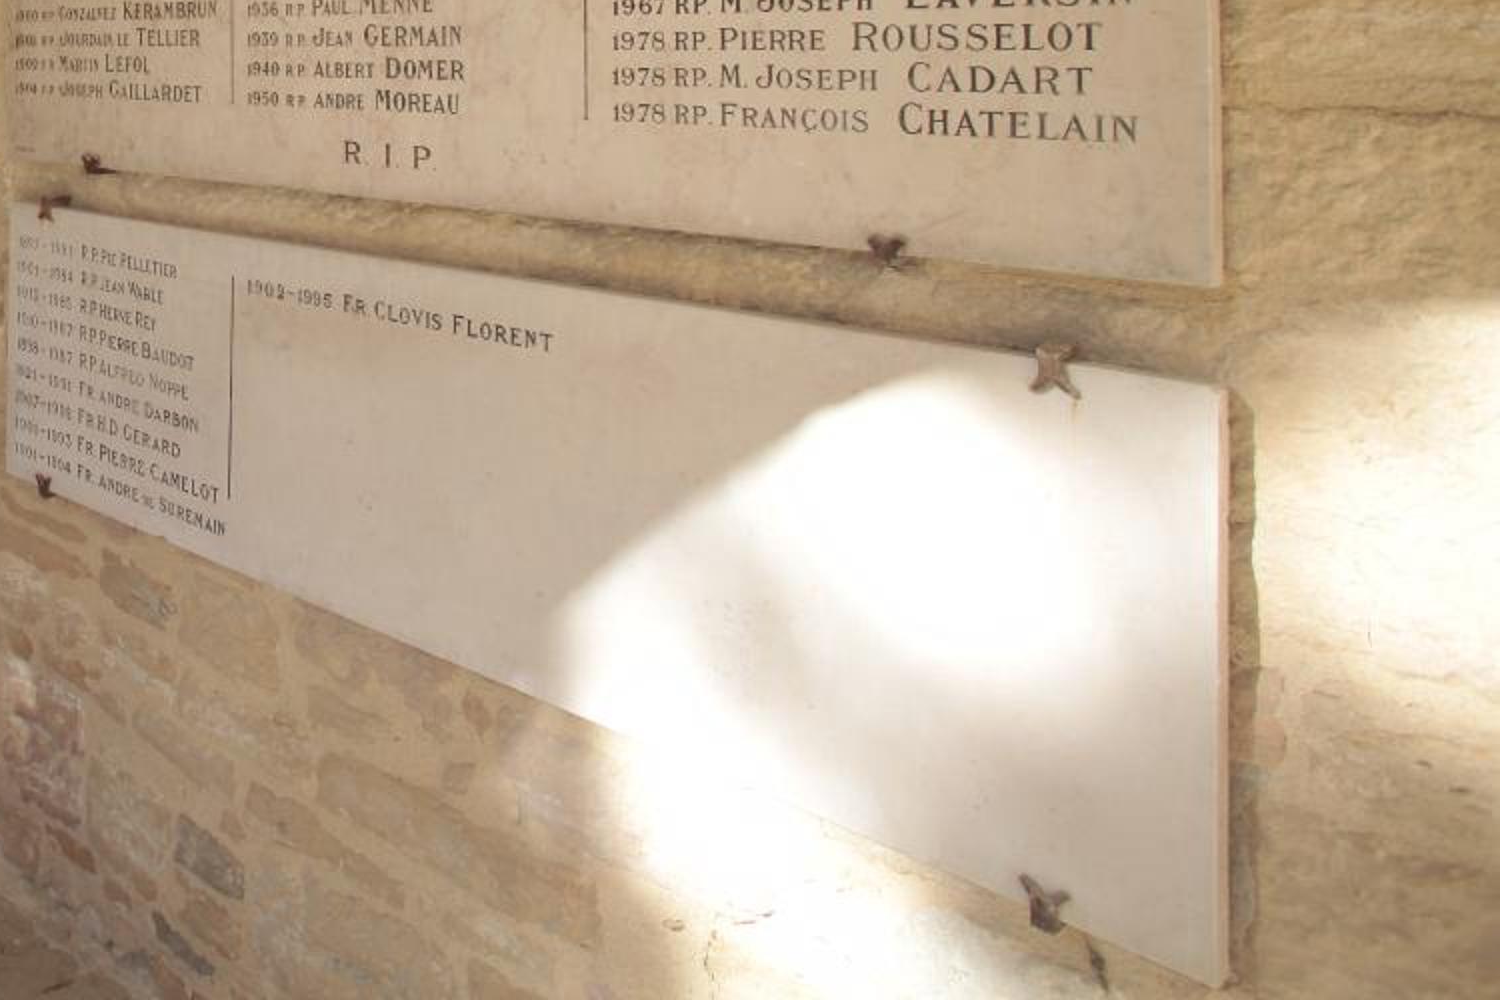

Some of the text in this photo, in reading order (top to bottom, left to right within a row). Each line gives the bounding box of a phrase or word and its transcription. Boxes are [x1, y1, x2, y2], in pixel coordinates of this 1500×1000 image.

[136, 27, 199, 47] TELLIER
[311, 27, 352, 46] JEAN
[363, 24, 460, 46] GERMAIN
[613, 31, 665, 50] 1978
[720, 27, 823, 50] PIERRE
[853, 21, 1096, 51] ROUSSELOT
[105, 53, 149, 74] LEFOL
[314, 60, 373, 78] ALBERT
[385, 57, 463, 80] DOMER
[612, 67, 665, 86] 1978
[755, 64, 876, 90] JOSEPH
[907, 62, 1091, 94] CADART
[375, 89, 459, 114] MOREAU
[612, 102, 667, 124] 1978
[719, 102, 870, 134] FRANÇOIS
[899, 103, 1139, 143] CHATELAIN
[374, 301, 443, 331] CLOVIS
[453, 314, 554, 353] FLORENT
